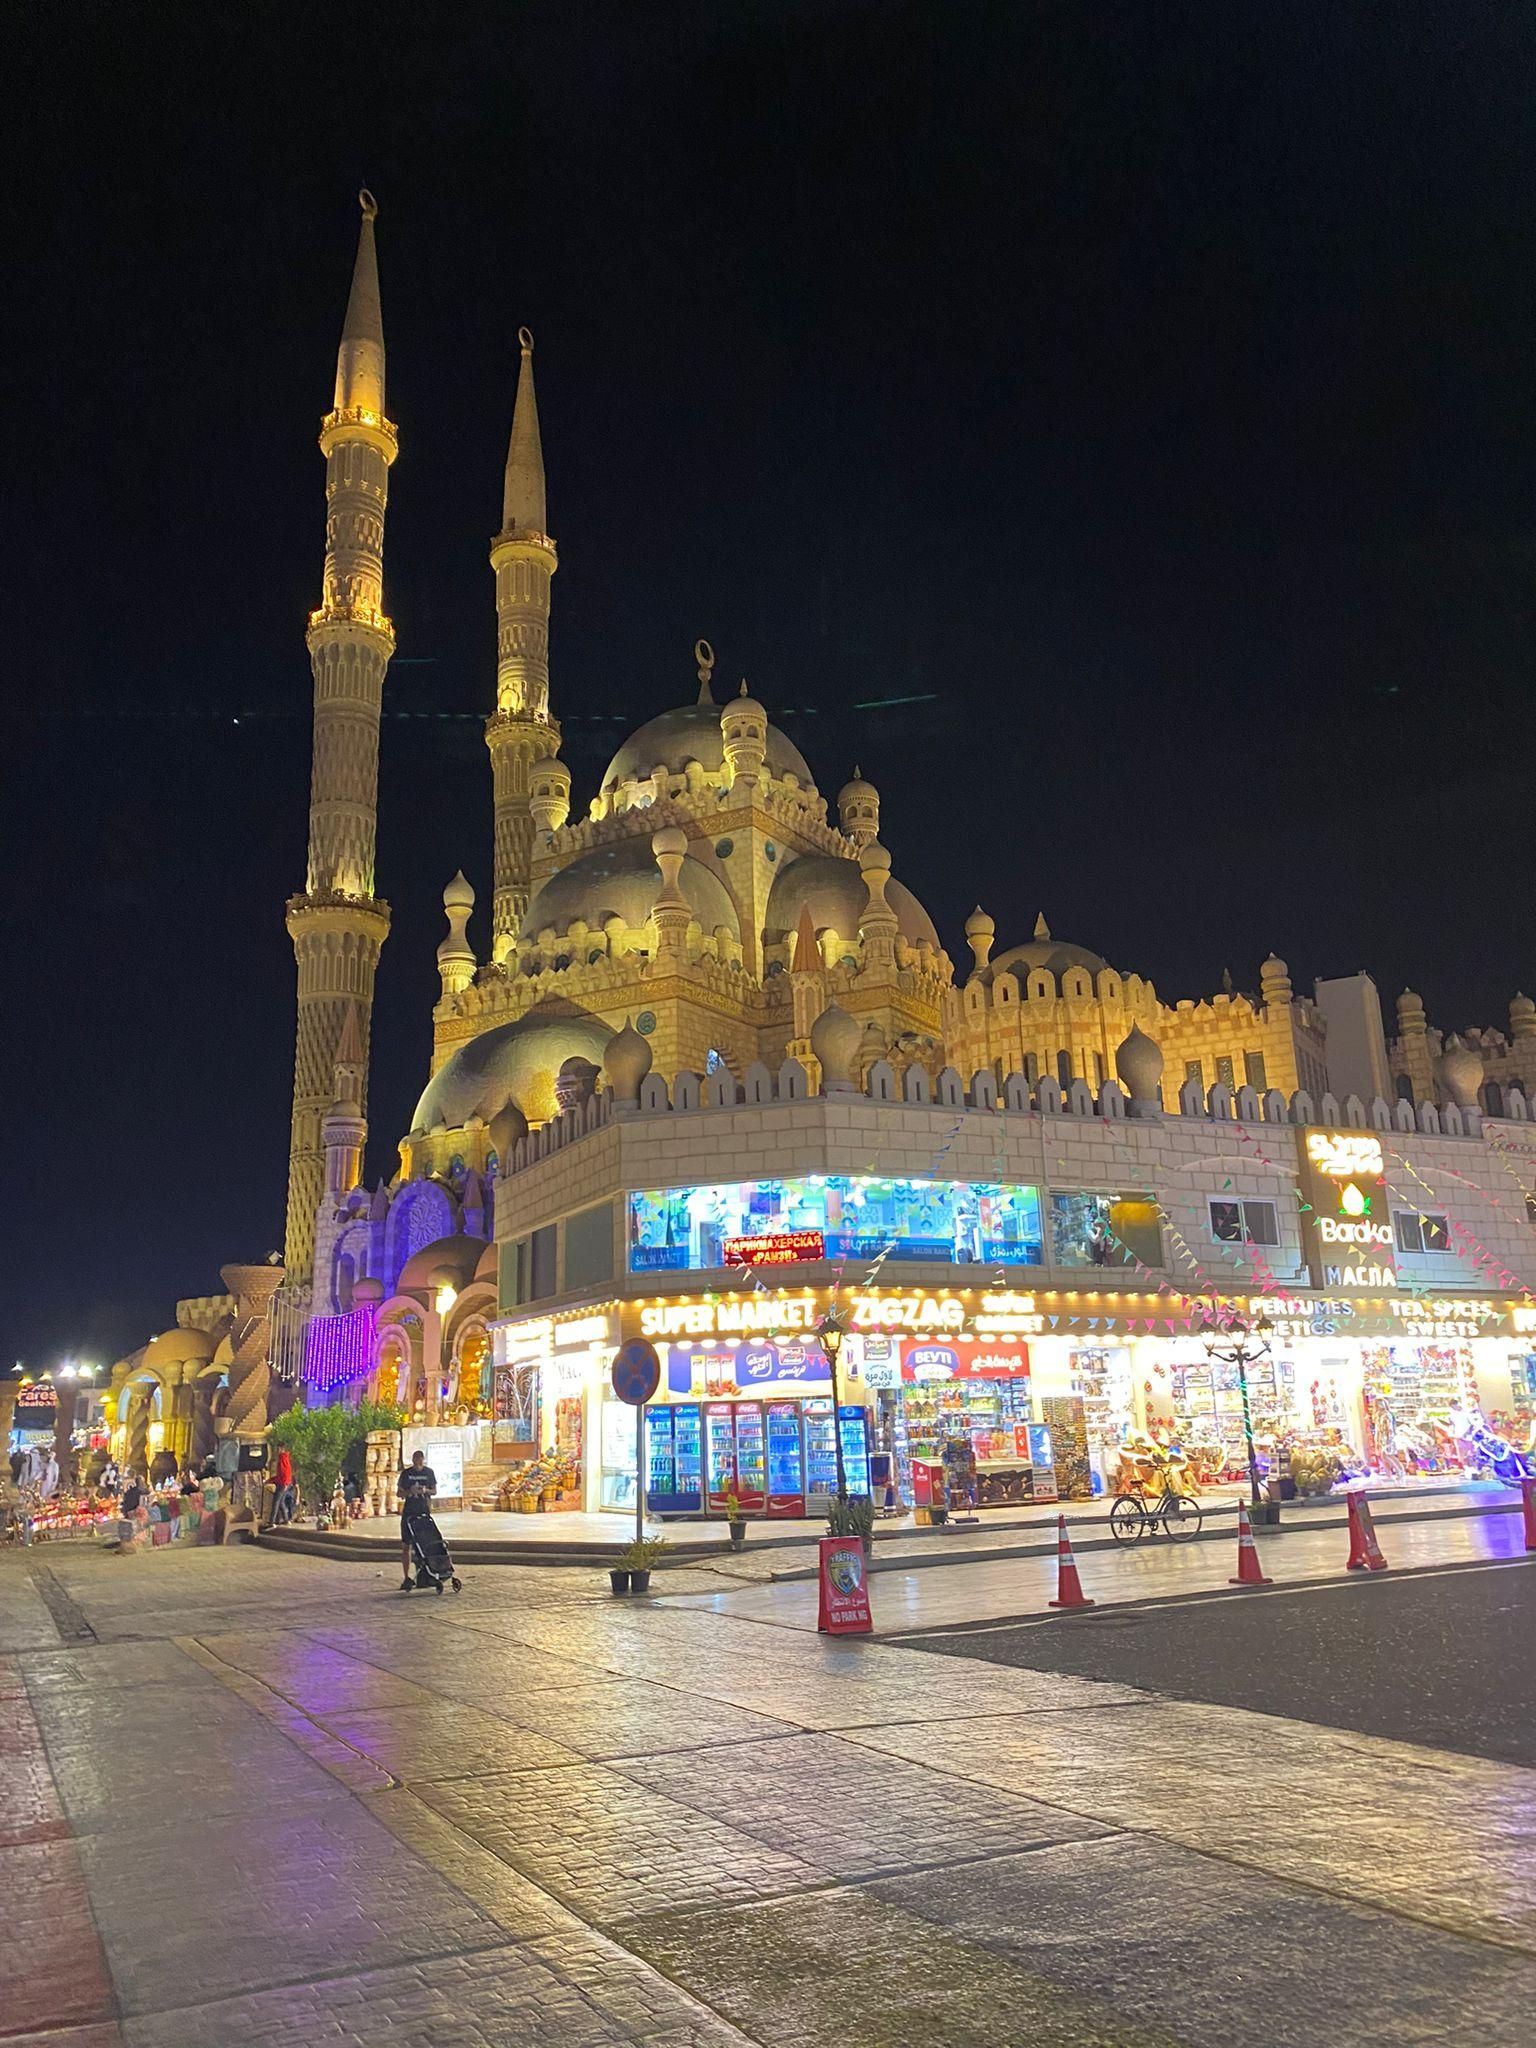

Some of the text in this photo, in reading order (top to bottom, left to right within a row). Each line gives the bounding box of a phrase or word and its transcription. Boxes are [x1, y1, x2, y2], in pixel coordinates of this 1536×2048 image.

[1320, 1217, 1394, 1244] Baraka
[640, 1304, 715, 1335] SUPER
[717, 1297, 817, 1331] MARKET
[851, 1297, 965, 1326] ZIGZAG
[1406, 1321, 1480, 1337] SWEETS
[914, 1351, 952, 1364] BEYTI
[17, 1388, 57, 1400] Fares
